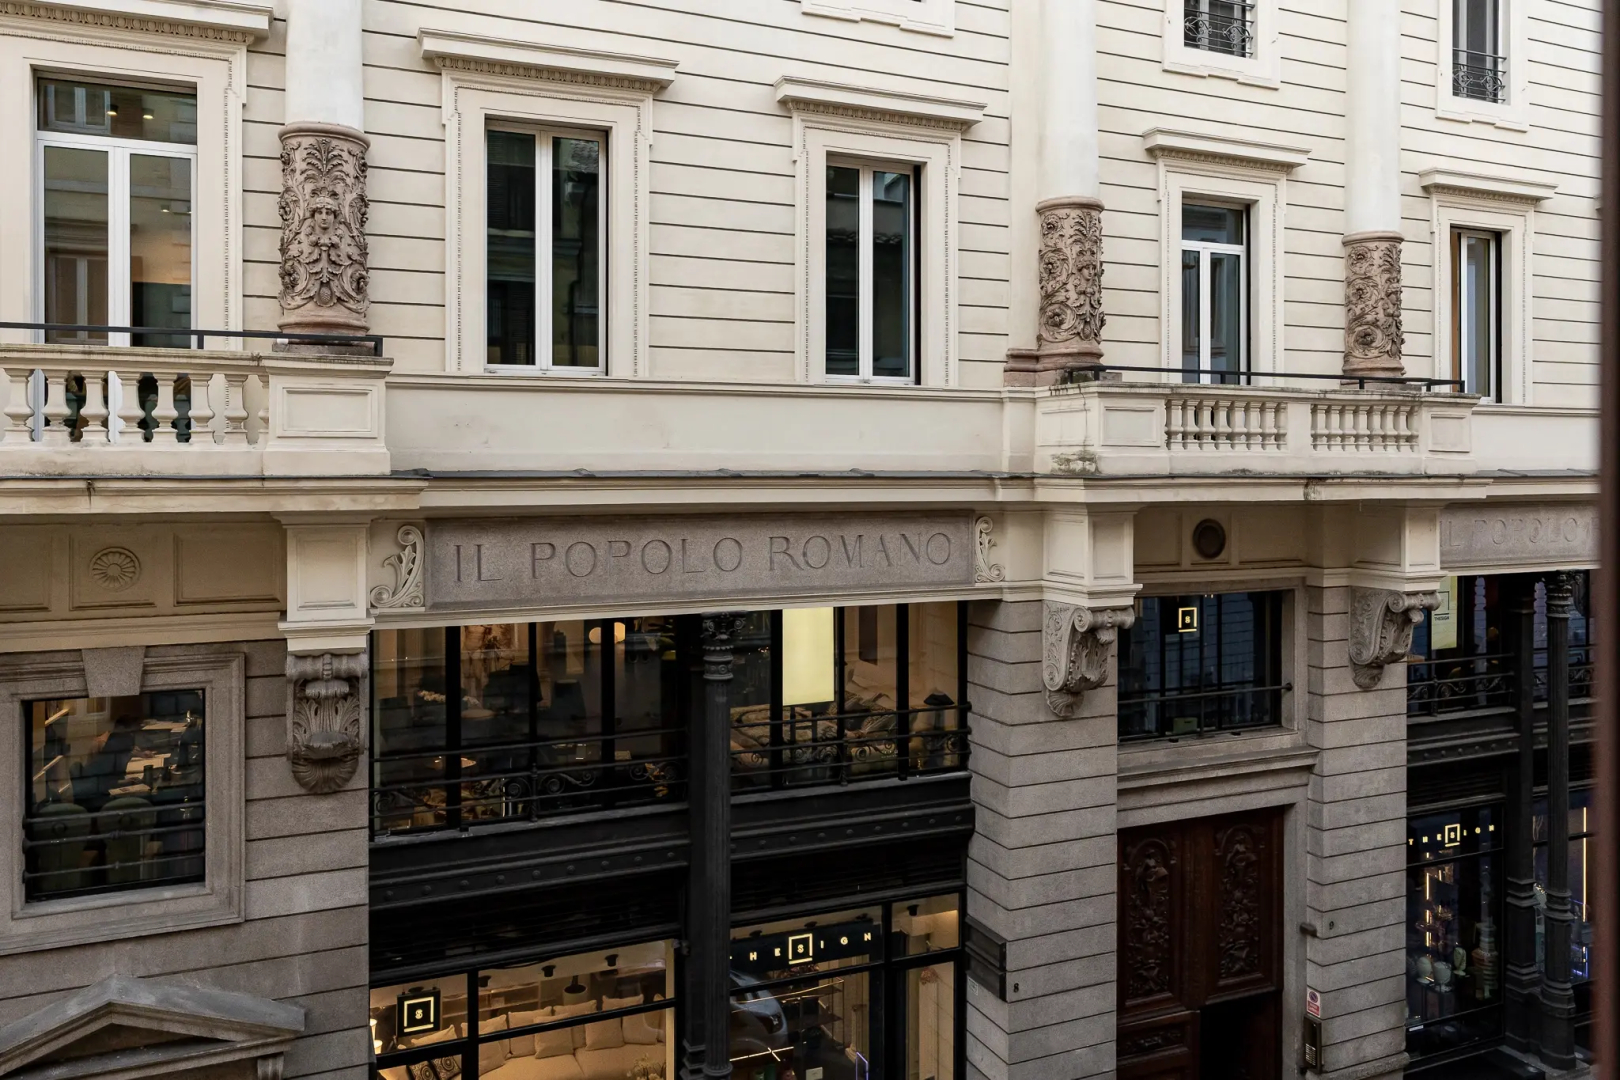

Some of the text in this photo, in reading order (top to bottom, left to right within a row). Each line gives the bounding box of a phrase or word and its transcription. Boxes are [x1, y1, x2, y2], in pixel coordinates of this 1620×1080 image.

[1471, 518, 1577, 546] POPOLO
[454, 532, 952, 582] IL POPOLO ROMANO
